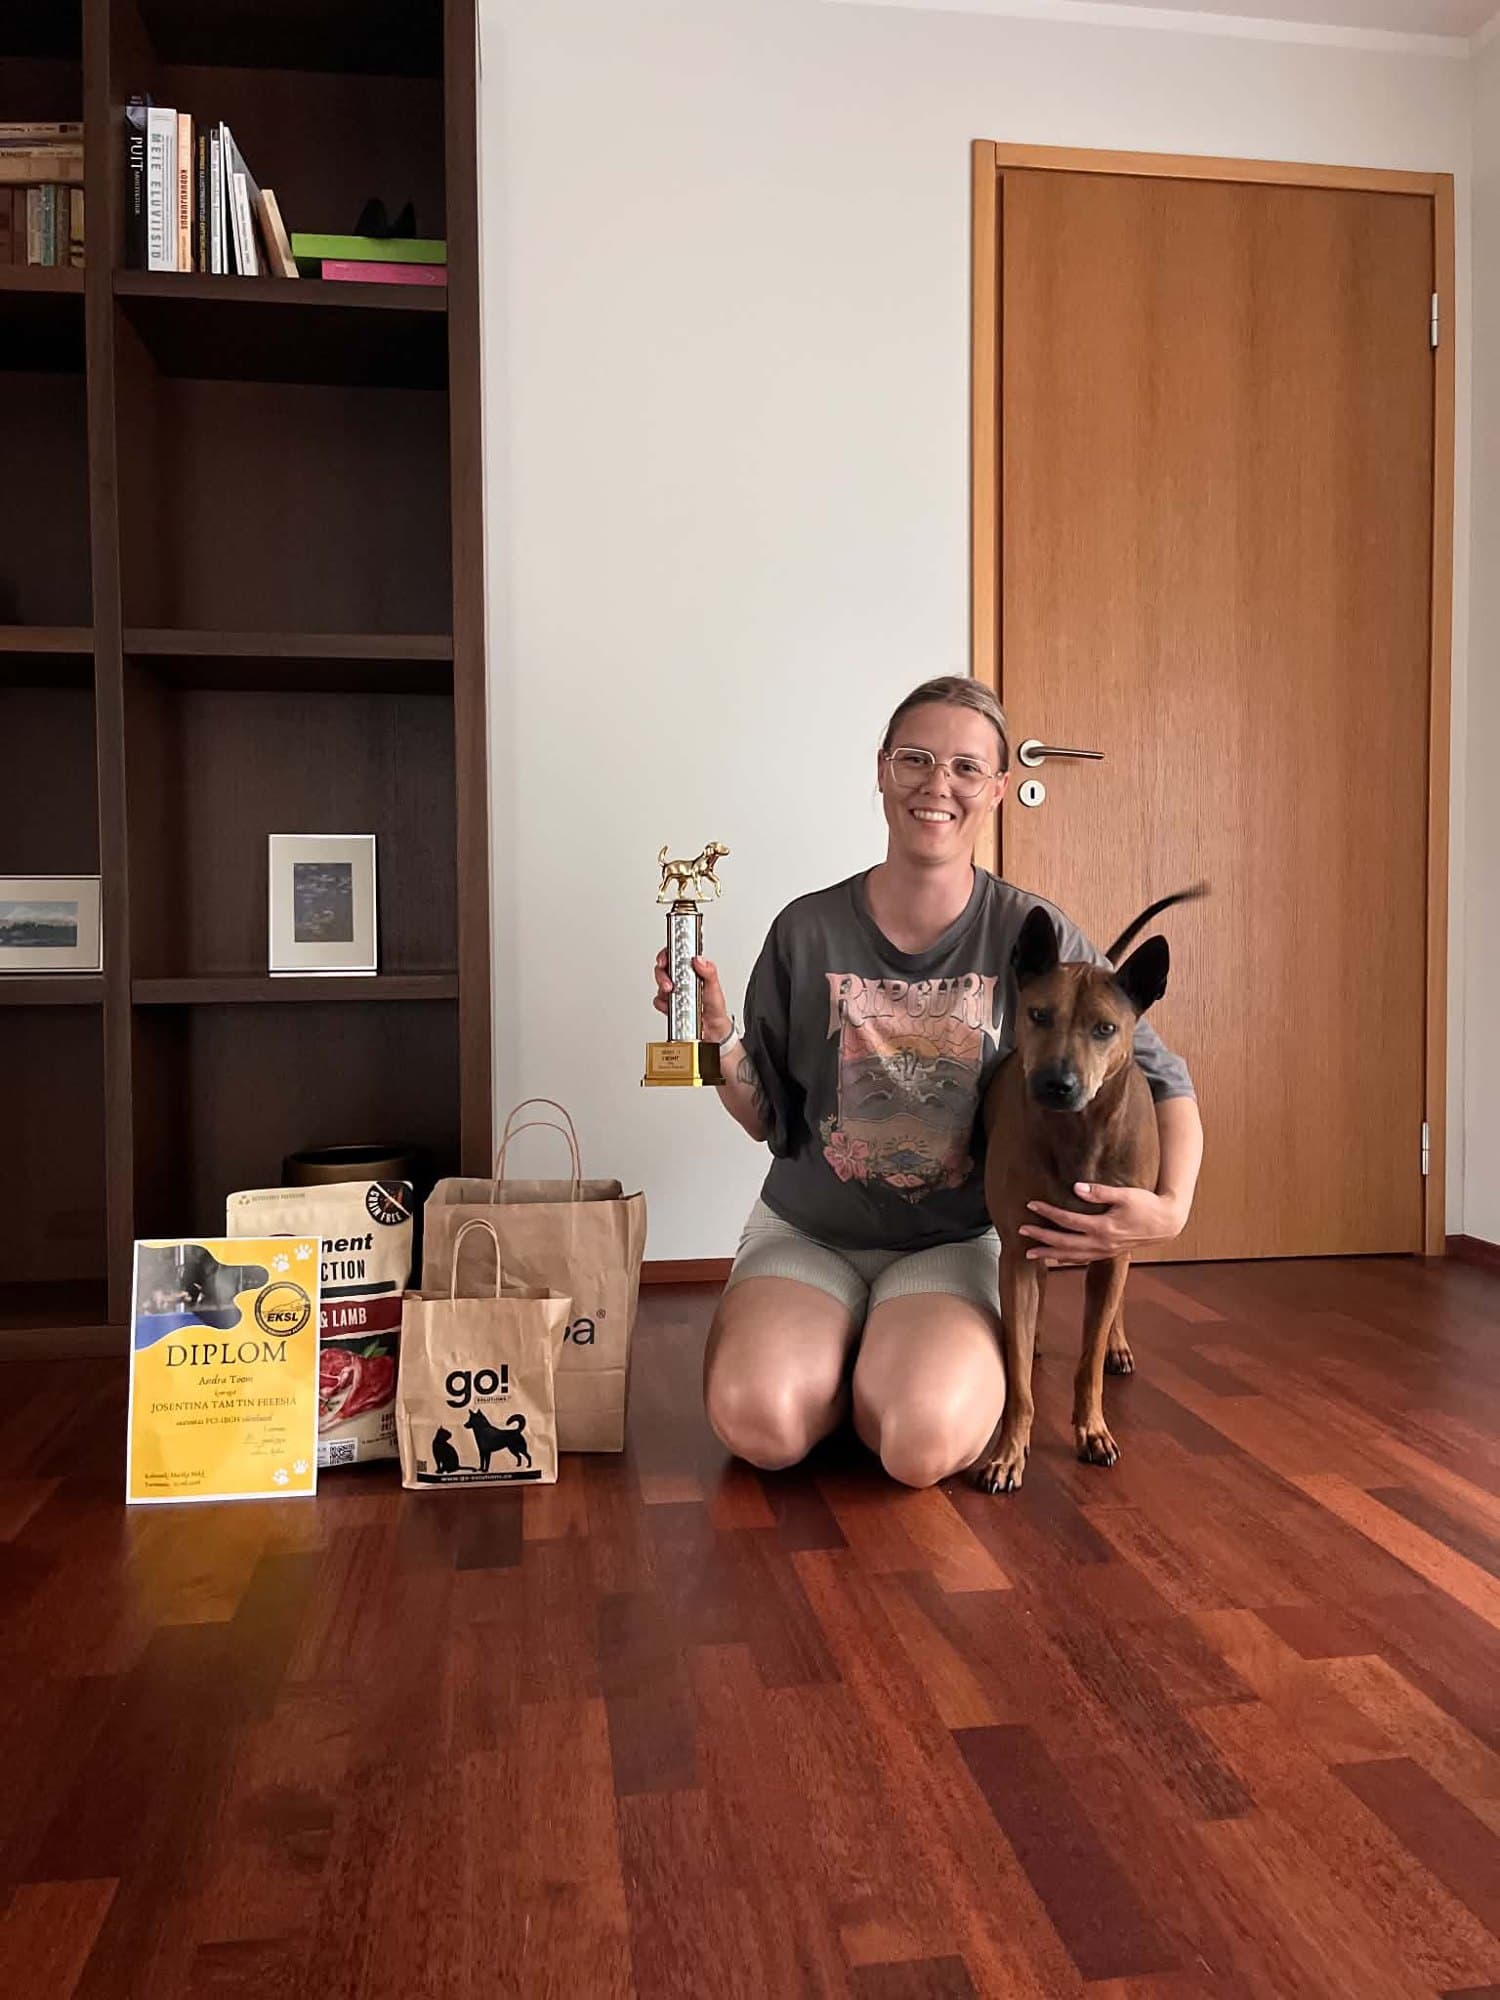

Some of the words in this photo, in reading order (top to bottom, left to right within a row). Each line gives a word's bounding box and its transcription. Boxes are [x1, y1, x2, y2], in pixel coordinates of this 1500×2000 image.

[130, 137, 144, 171] PUIT
[151, 133, 161, 170] MEIE
[180, 169, 188, 230] KODUKUJUNDUS
[151, 180, 161, 259] ELUVIISID
[368, 1190, 383, 1217] GRAIN
[380, 1212, 402, 1224] FREE
[267, 1312, 298, 1322] EKSL
[332, 1307, 367, 1327] LAMB
[166, 1340, 287, 1367] DIPLOM
[445, 1364, 508, 1408] go!
